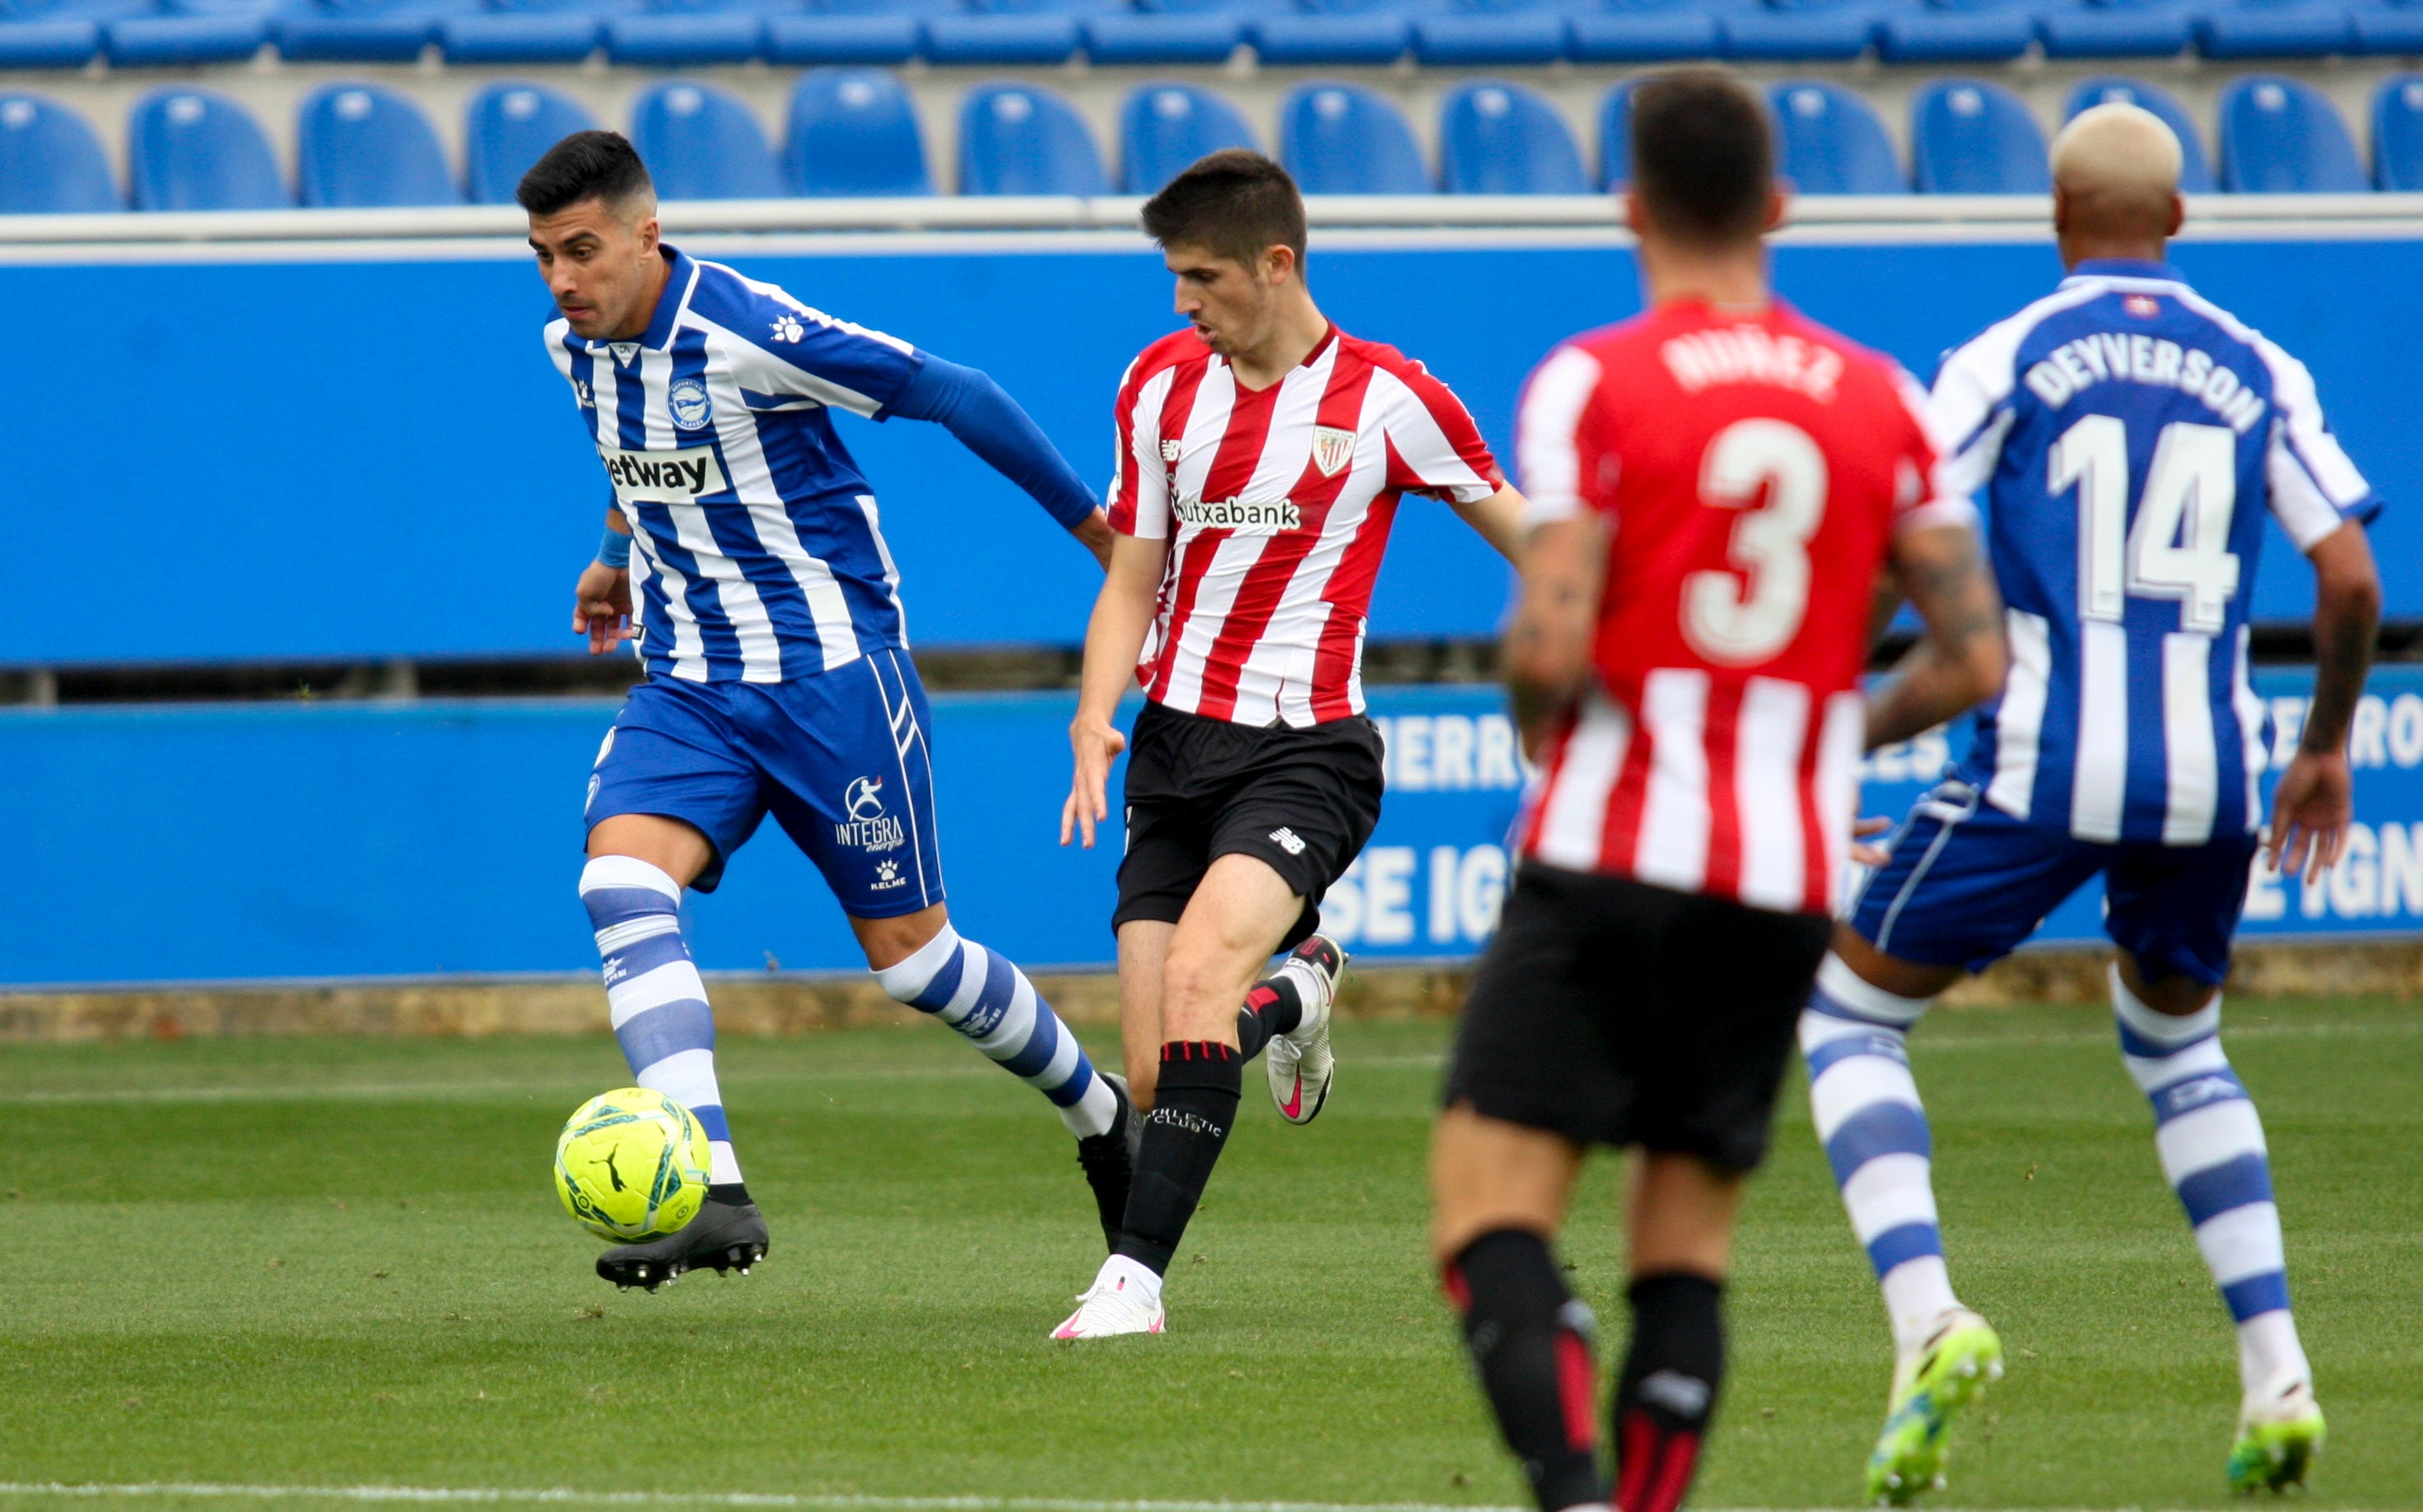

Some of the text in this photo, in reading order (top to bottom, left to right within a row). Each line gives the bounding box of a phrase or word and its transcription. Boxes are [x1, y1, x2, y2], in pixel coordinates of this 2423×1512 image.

[2024, 333, 2266, 435] DEYVERSON
[2047, 413, 2239, 635] 14
[1678, 416, 1829, 668] 3
[835, 815, 905, 846] INTEGRA
[870, 877, 906, 891] KELME
[1147, 1108, 1222, 1137] THLETIC
[1154, 1114, 1200, 1133] CLUB
